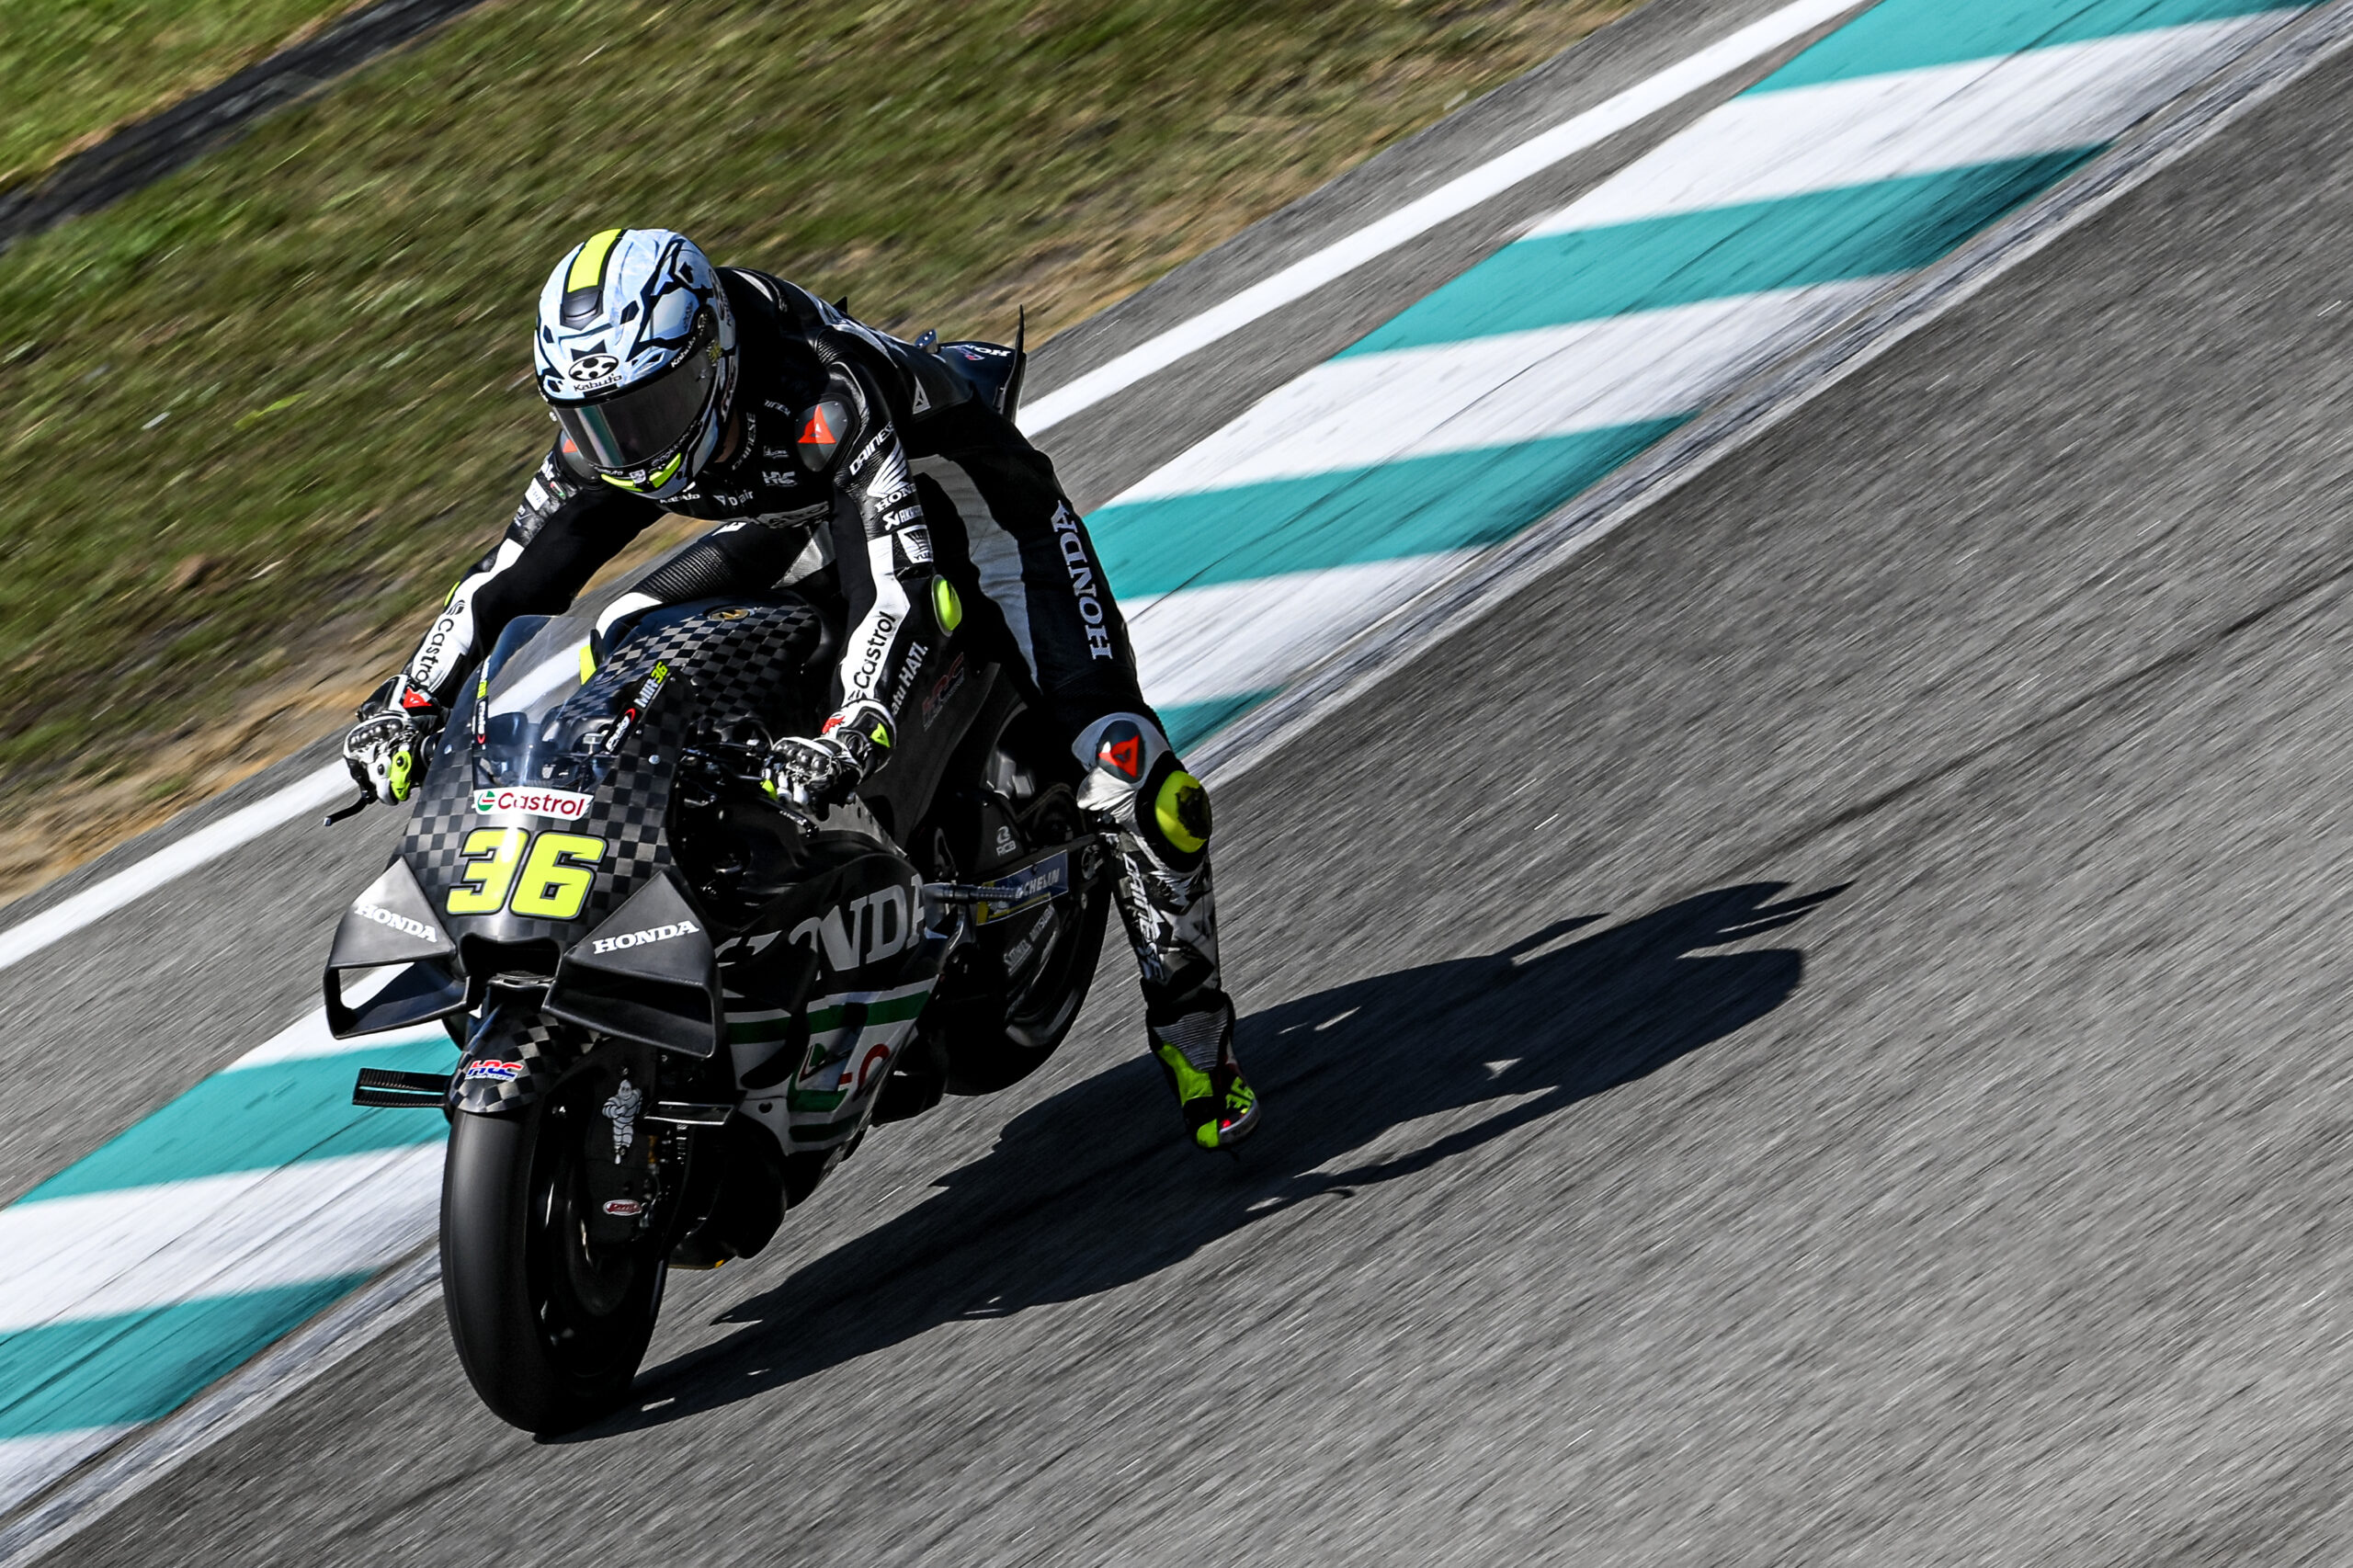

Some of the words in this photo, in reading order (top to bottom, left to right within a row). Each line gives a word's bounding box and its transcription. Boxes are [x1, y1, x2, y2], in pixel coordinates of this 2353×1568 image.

[573, 372, 622, 392] Kabuto
[849, 421, 893, 476] DAINES
[1051, 500, 1113, 659] HONDA
[415, 618, 455, 684] Castro
[854, 611, 897, 690] Castrol
[651, 661, 669, 684] 36
[891, 684, 907, 719] atu
[497, 790, 586, 817] Castrol
[445, 826, 608, 920] 36
[1022, 868, 1061, 898] CHELIN
[354, 903, 439, 944] HONDA
[592, 920, 699, 955] HONDA
[466, 1060, 523, 1079] HRC
